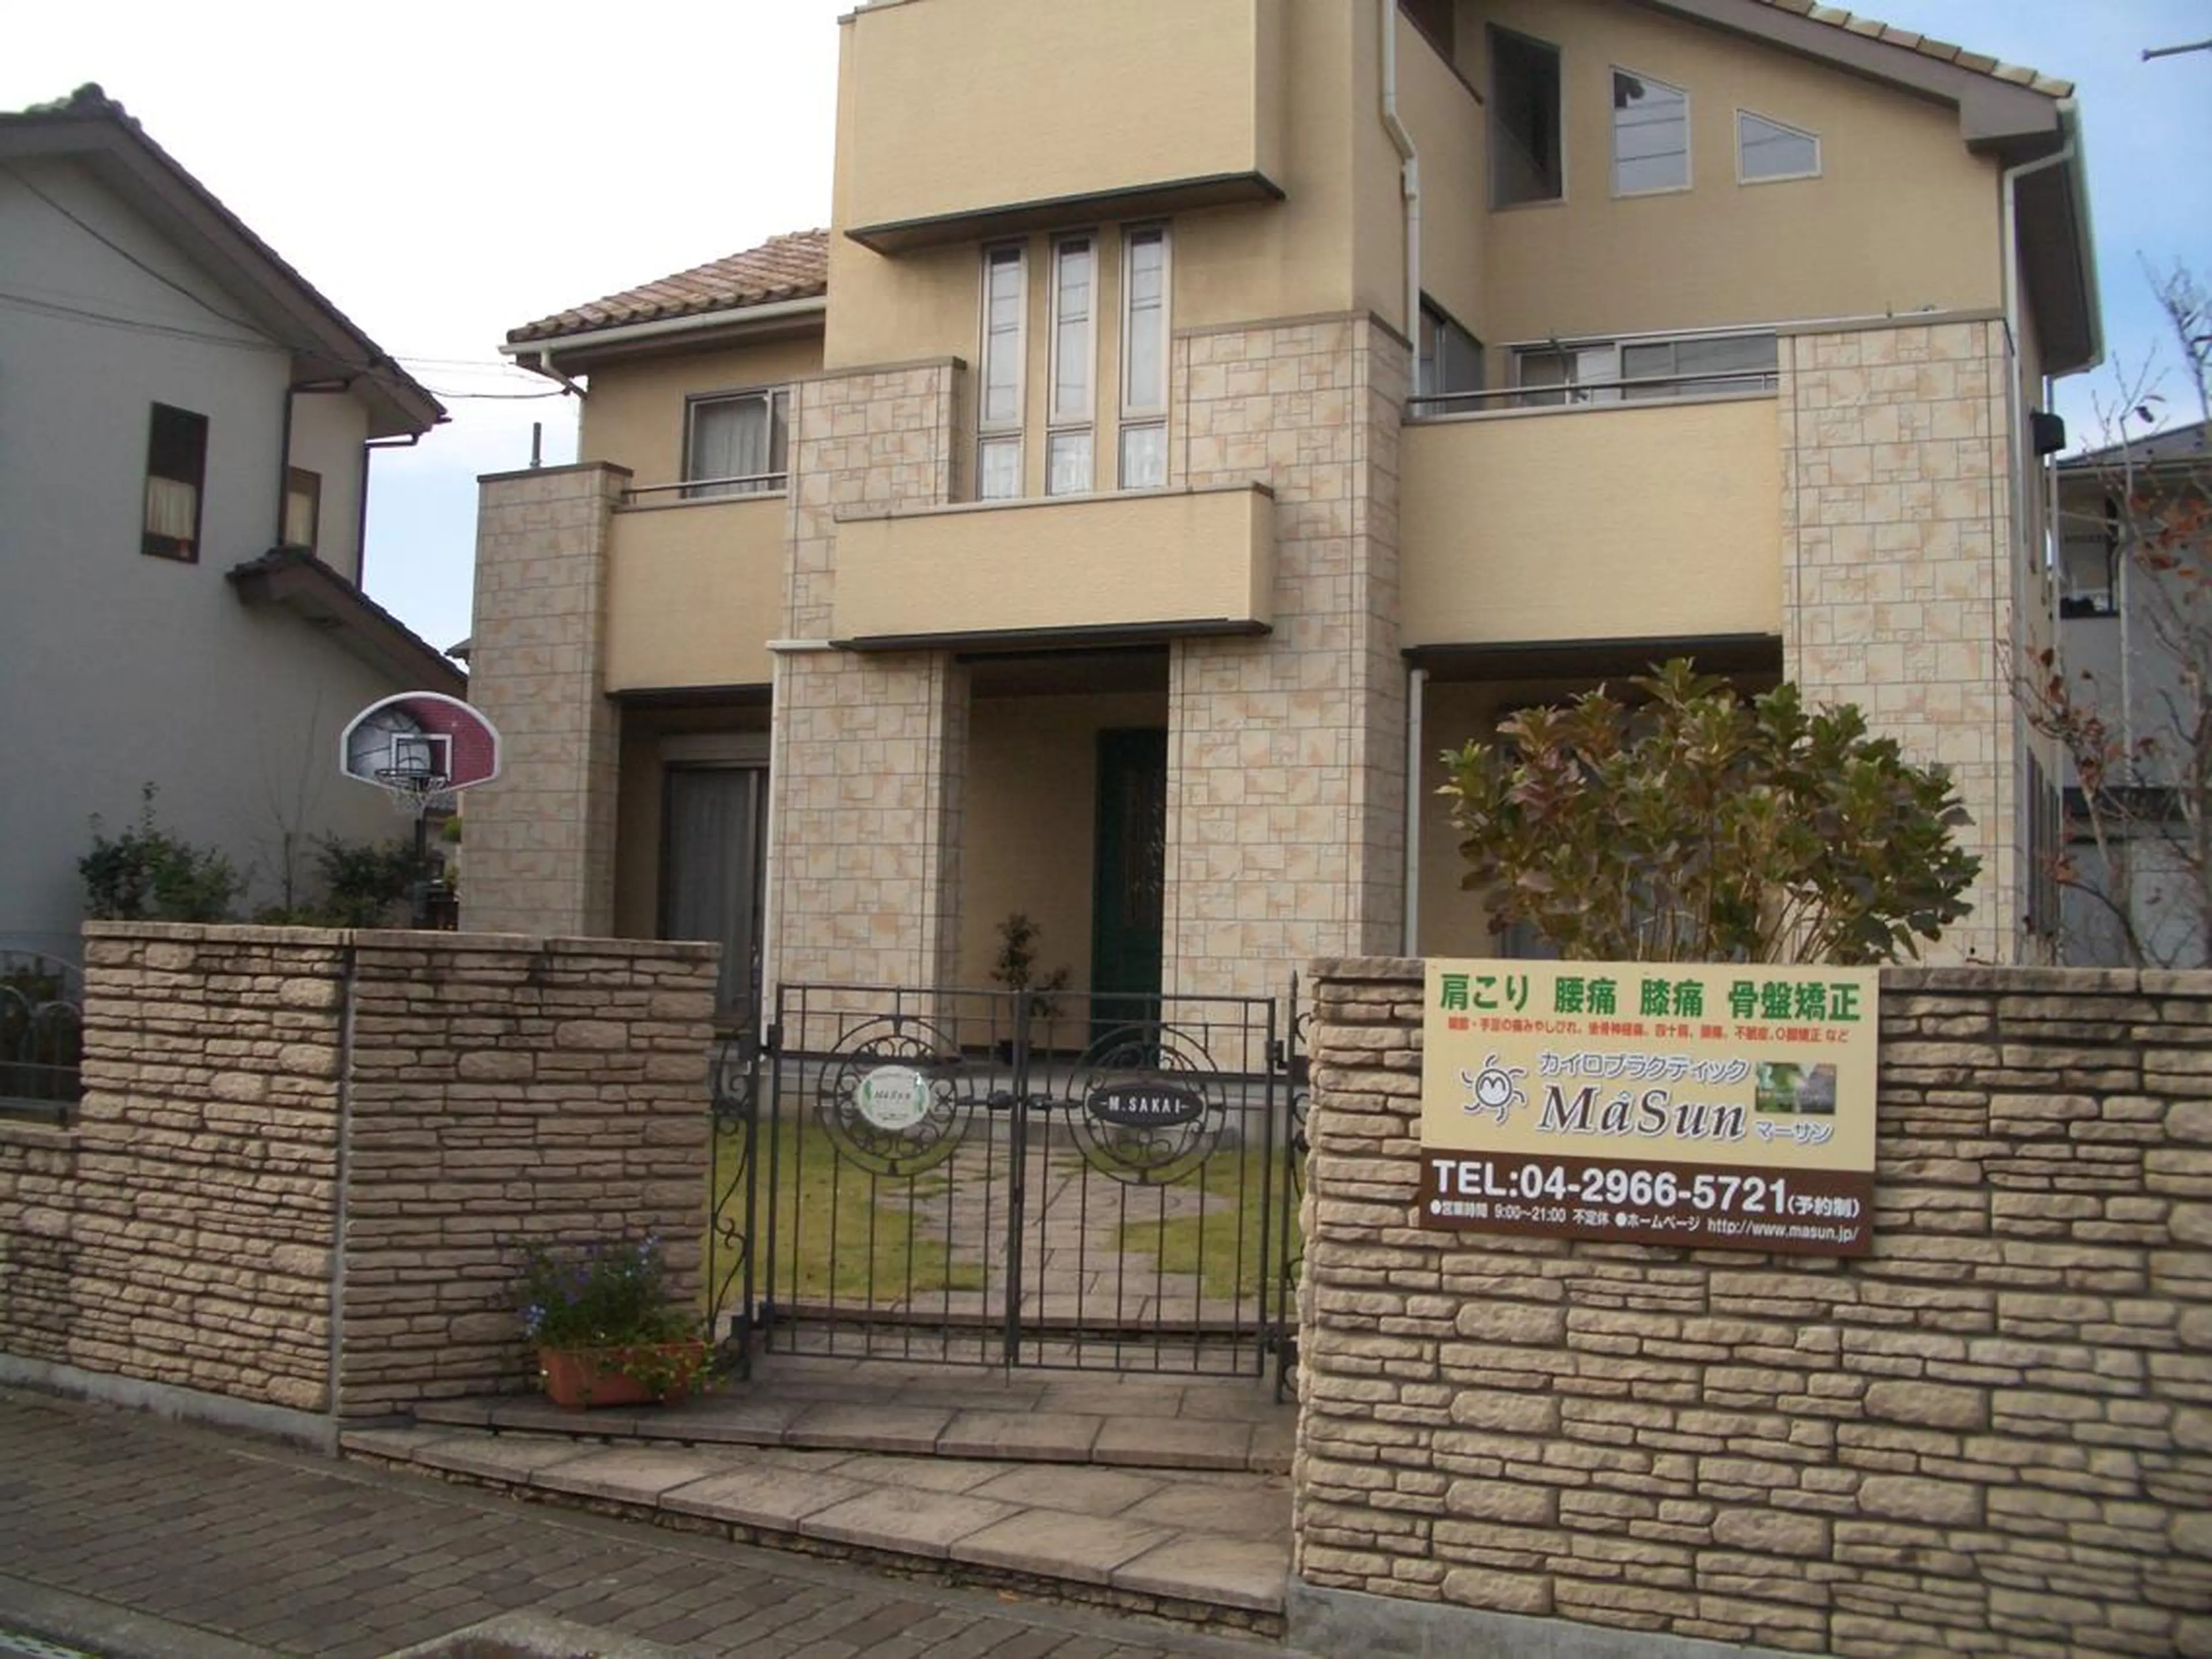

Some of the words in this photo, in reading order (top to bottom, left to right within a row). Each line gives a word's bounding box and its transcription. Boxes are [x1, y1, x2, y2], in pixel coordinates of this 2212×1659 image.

[1441, 974, 1528, 1012] 肩こり
[1554, 976, 1618, 1016] 腰痛
[1640, 978, 1703, 1017] 膝痛
[1728, 980, 1861, 1021] 骨盤矯正
[1754, 1120, 1835, 1144] マーサン
